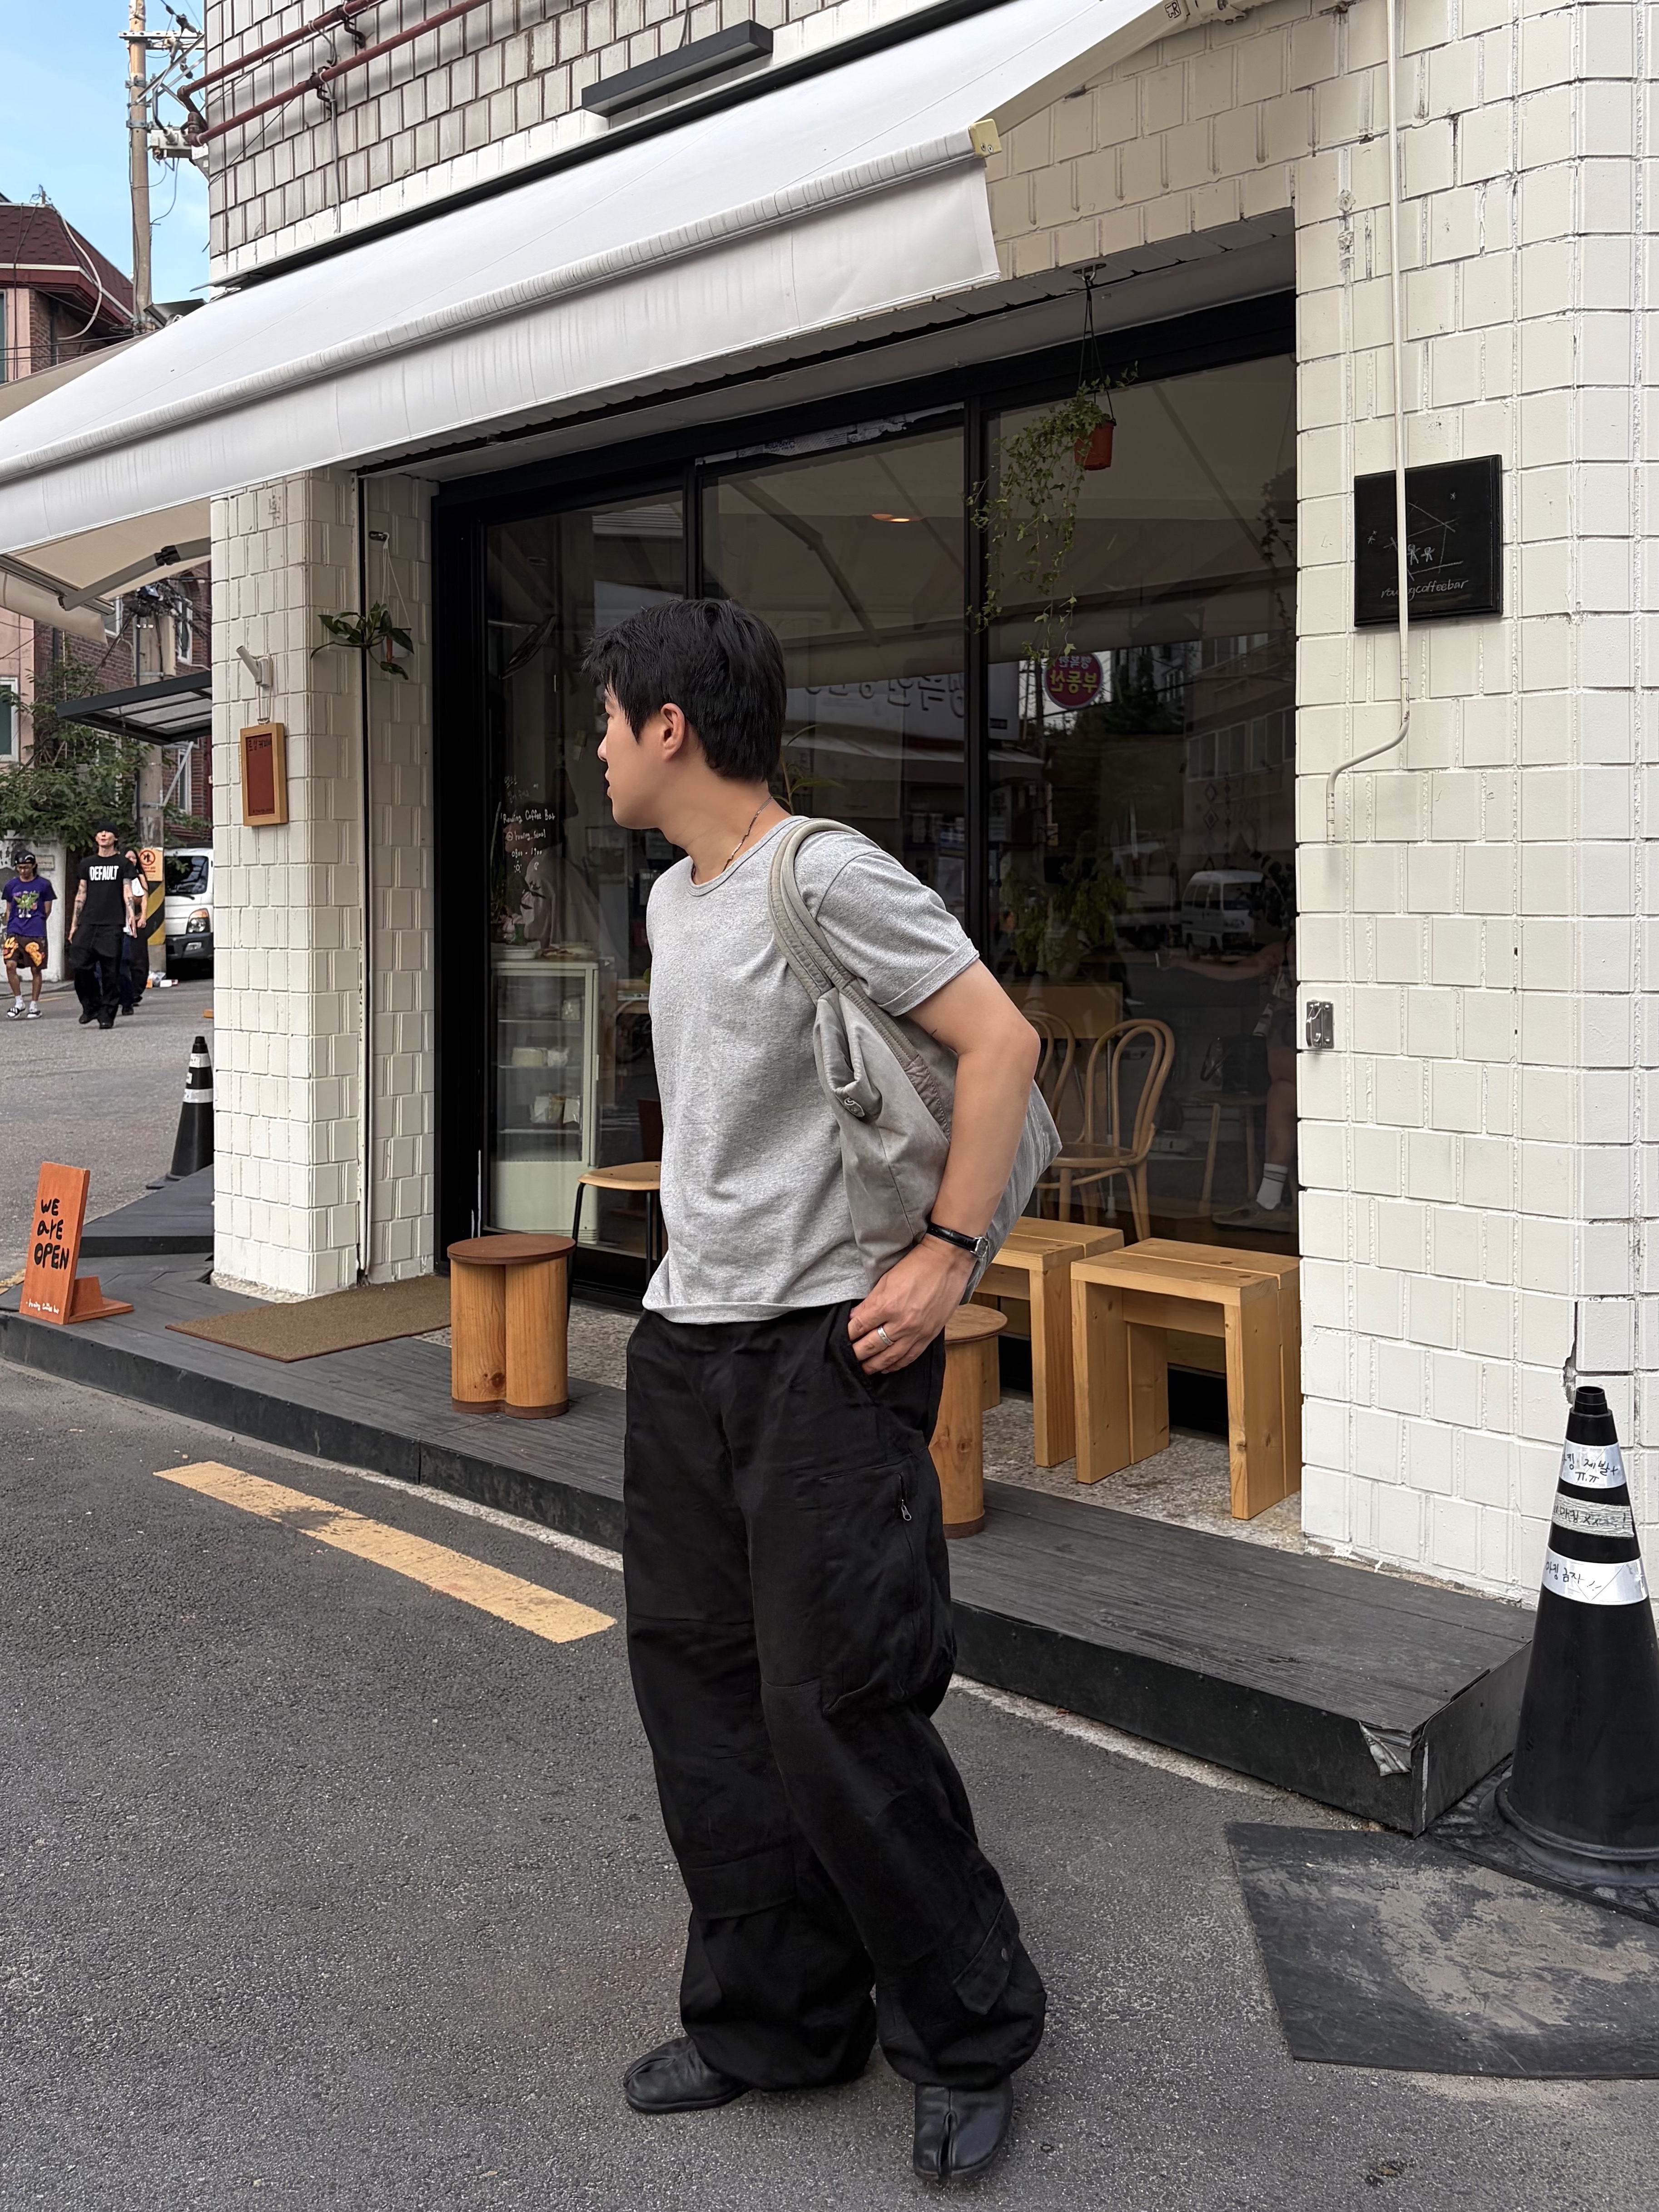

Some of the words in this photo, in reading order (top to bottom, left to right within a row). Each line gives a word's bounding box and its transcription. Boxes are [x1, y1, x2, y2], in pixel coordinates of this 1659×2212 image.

[89, 865, 119, 881] DEFAULT
[41, 1198, 60, 1216] WE
[34, 1243, 70, 1270] OPEN
